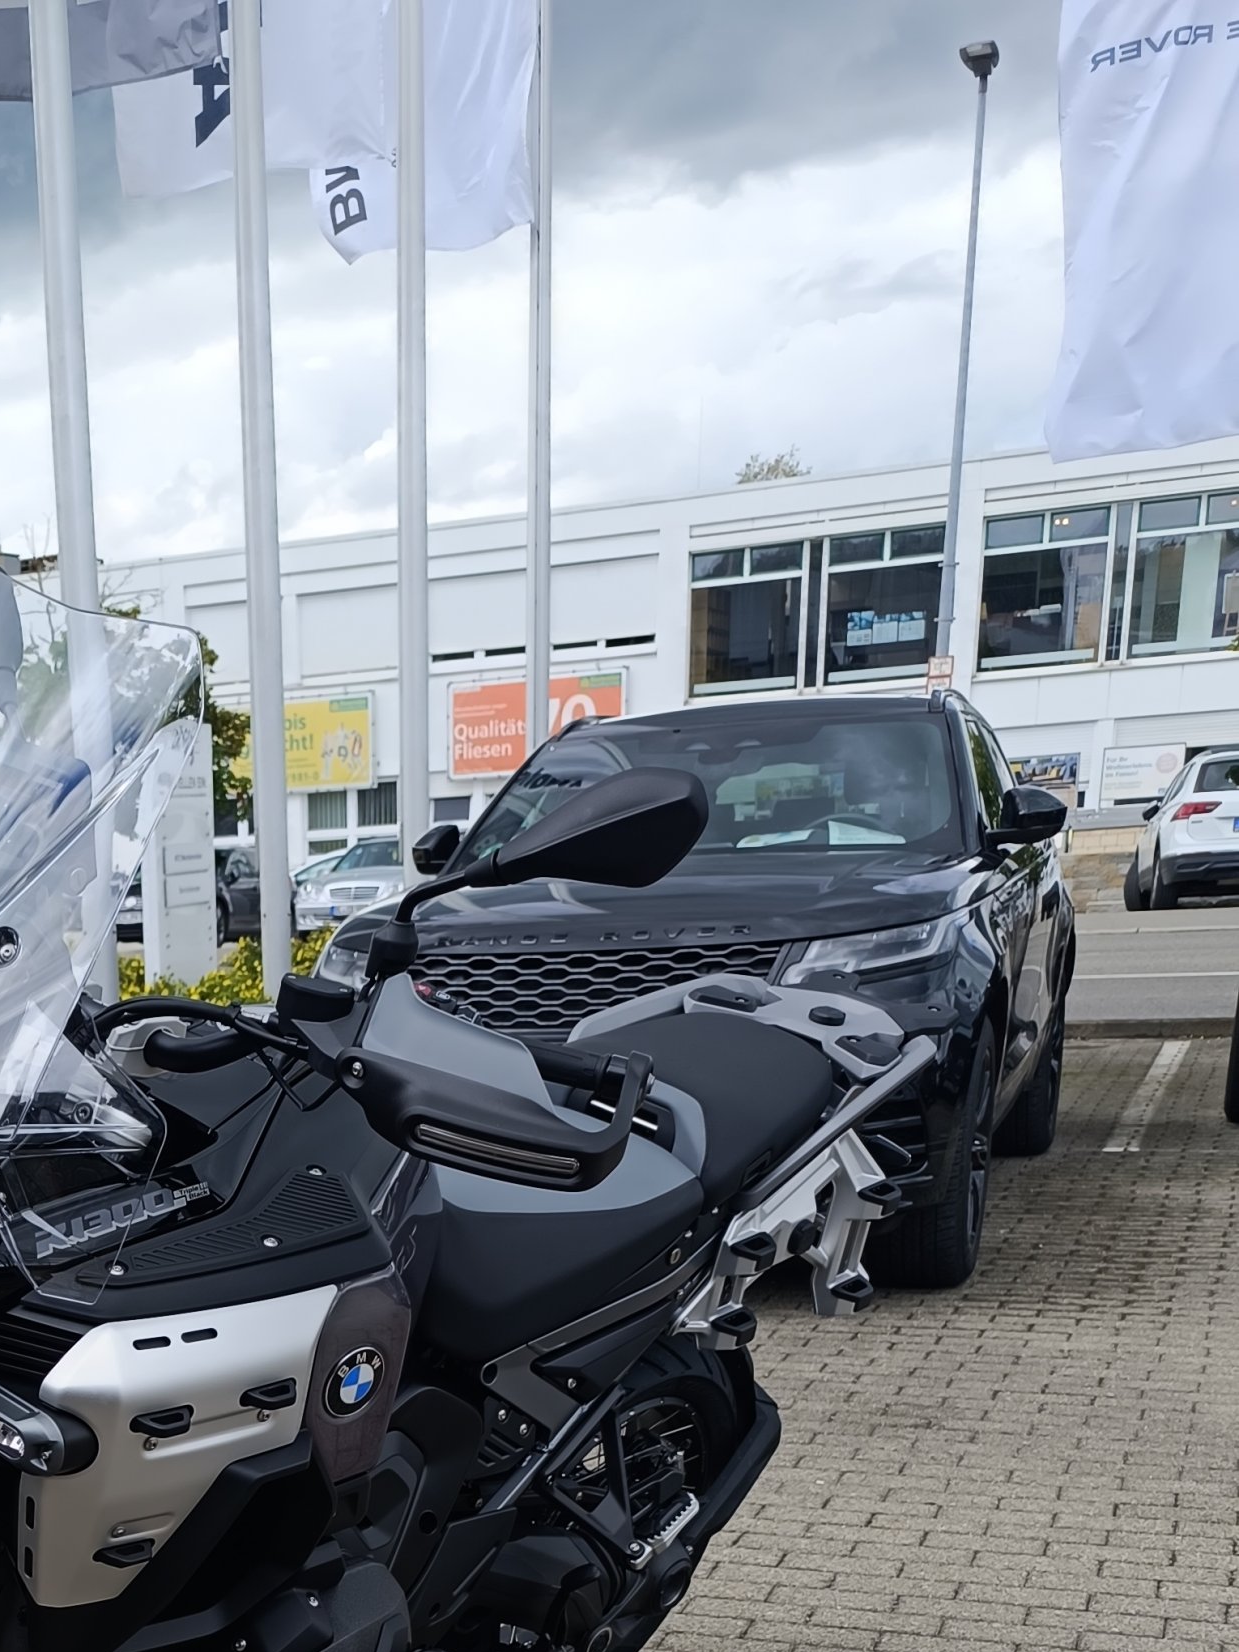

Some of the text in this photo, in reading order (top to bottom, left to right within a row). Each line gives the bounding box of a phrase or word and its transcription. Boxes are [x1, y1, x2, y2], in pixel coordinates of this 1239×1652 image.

[454, 718, 526, 742] Qualität
[454, 742, 513, 760] Fliesen
[434, 925, 751, 947] RANGE ROVER
[337, 1351, 382, 1378] BMW
